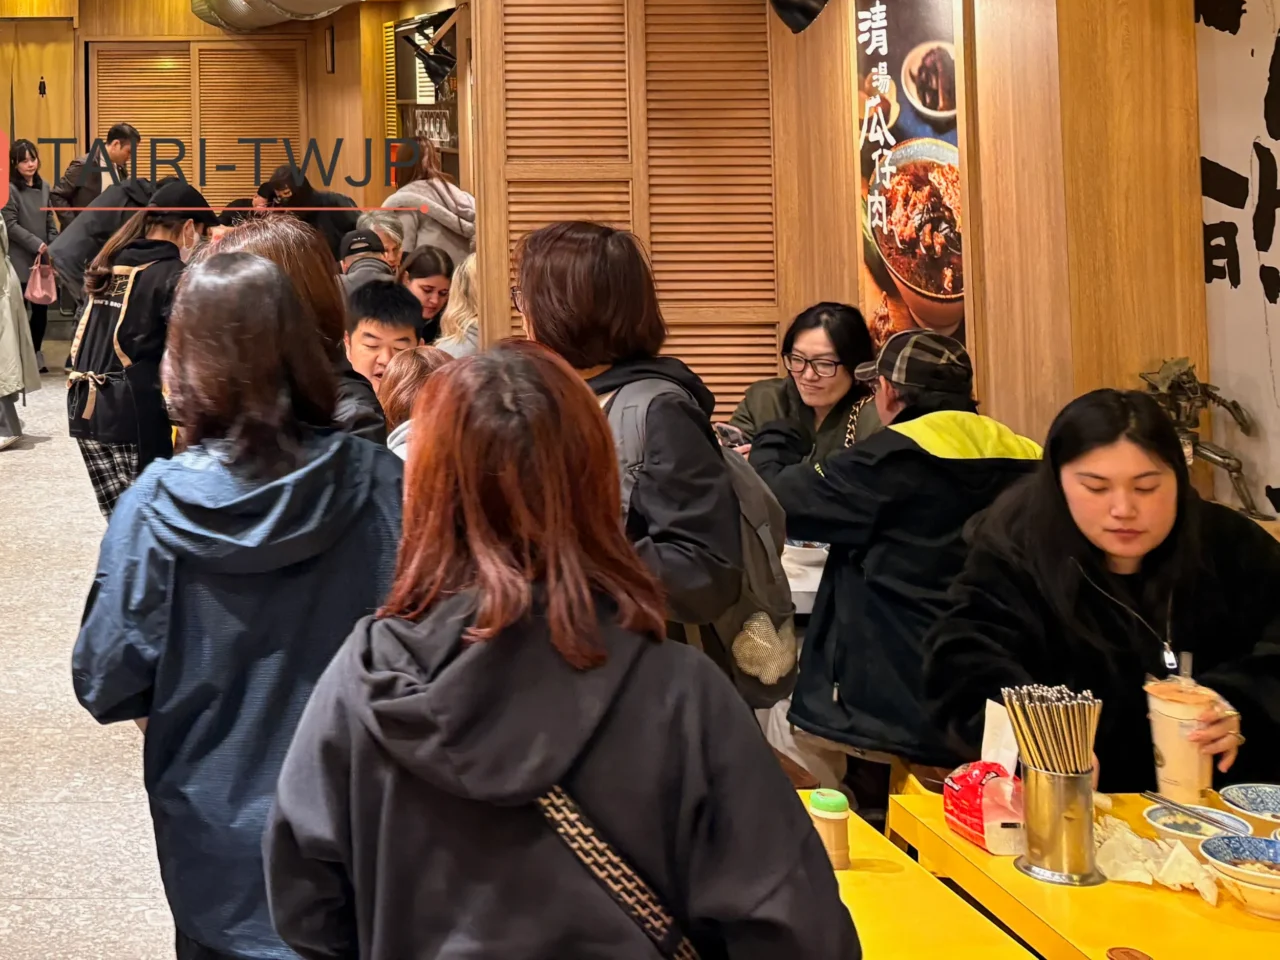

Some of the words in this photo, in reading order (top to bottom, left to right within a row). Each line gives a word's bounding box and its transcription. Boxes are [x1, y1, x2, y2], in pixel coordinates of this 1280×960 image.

[858, 0, 897, 235] 清湯瓜仔肉
